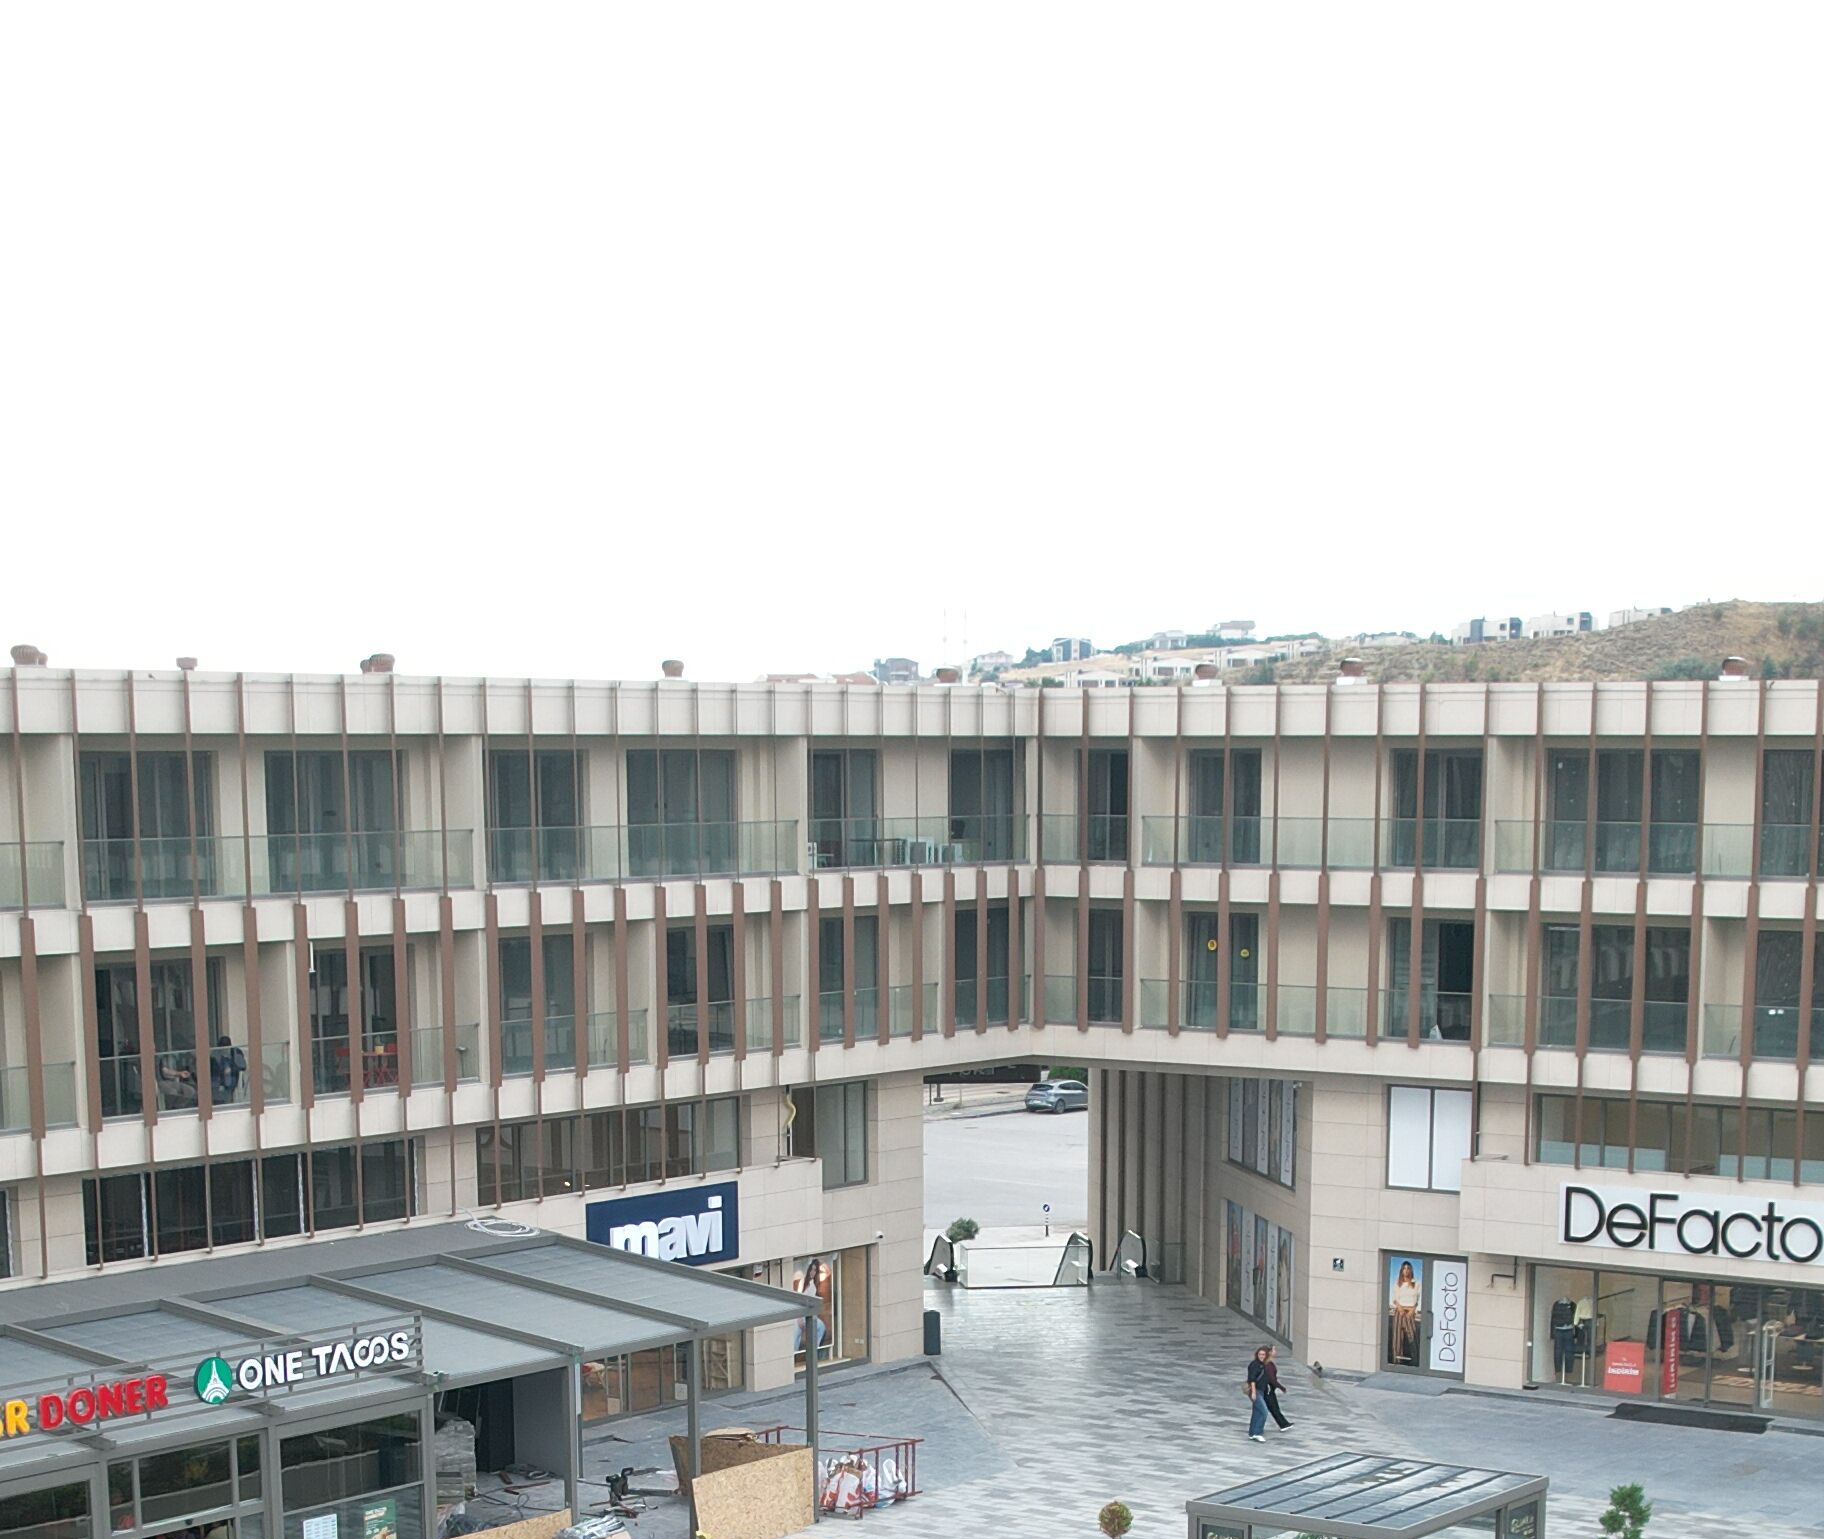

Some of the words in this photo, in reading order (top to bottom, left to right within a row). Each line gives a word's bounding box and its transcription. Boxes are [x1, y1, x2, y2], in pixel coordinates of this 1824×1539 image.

[609, 1195, 723, 1261] mavi
[1563, 1186, 1824, 1264] DeFacto
[1438, 1272, 1459, 1363] DeFacto
[238, 1351, 304, 1391] ONE
[312, 1331, 410, 1376] TACOS
[38, 1374, 169, 1431] DONER
